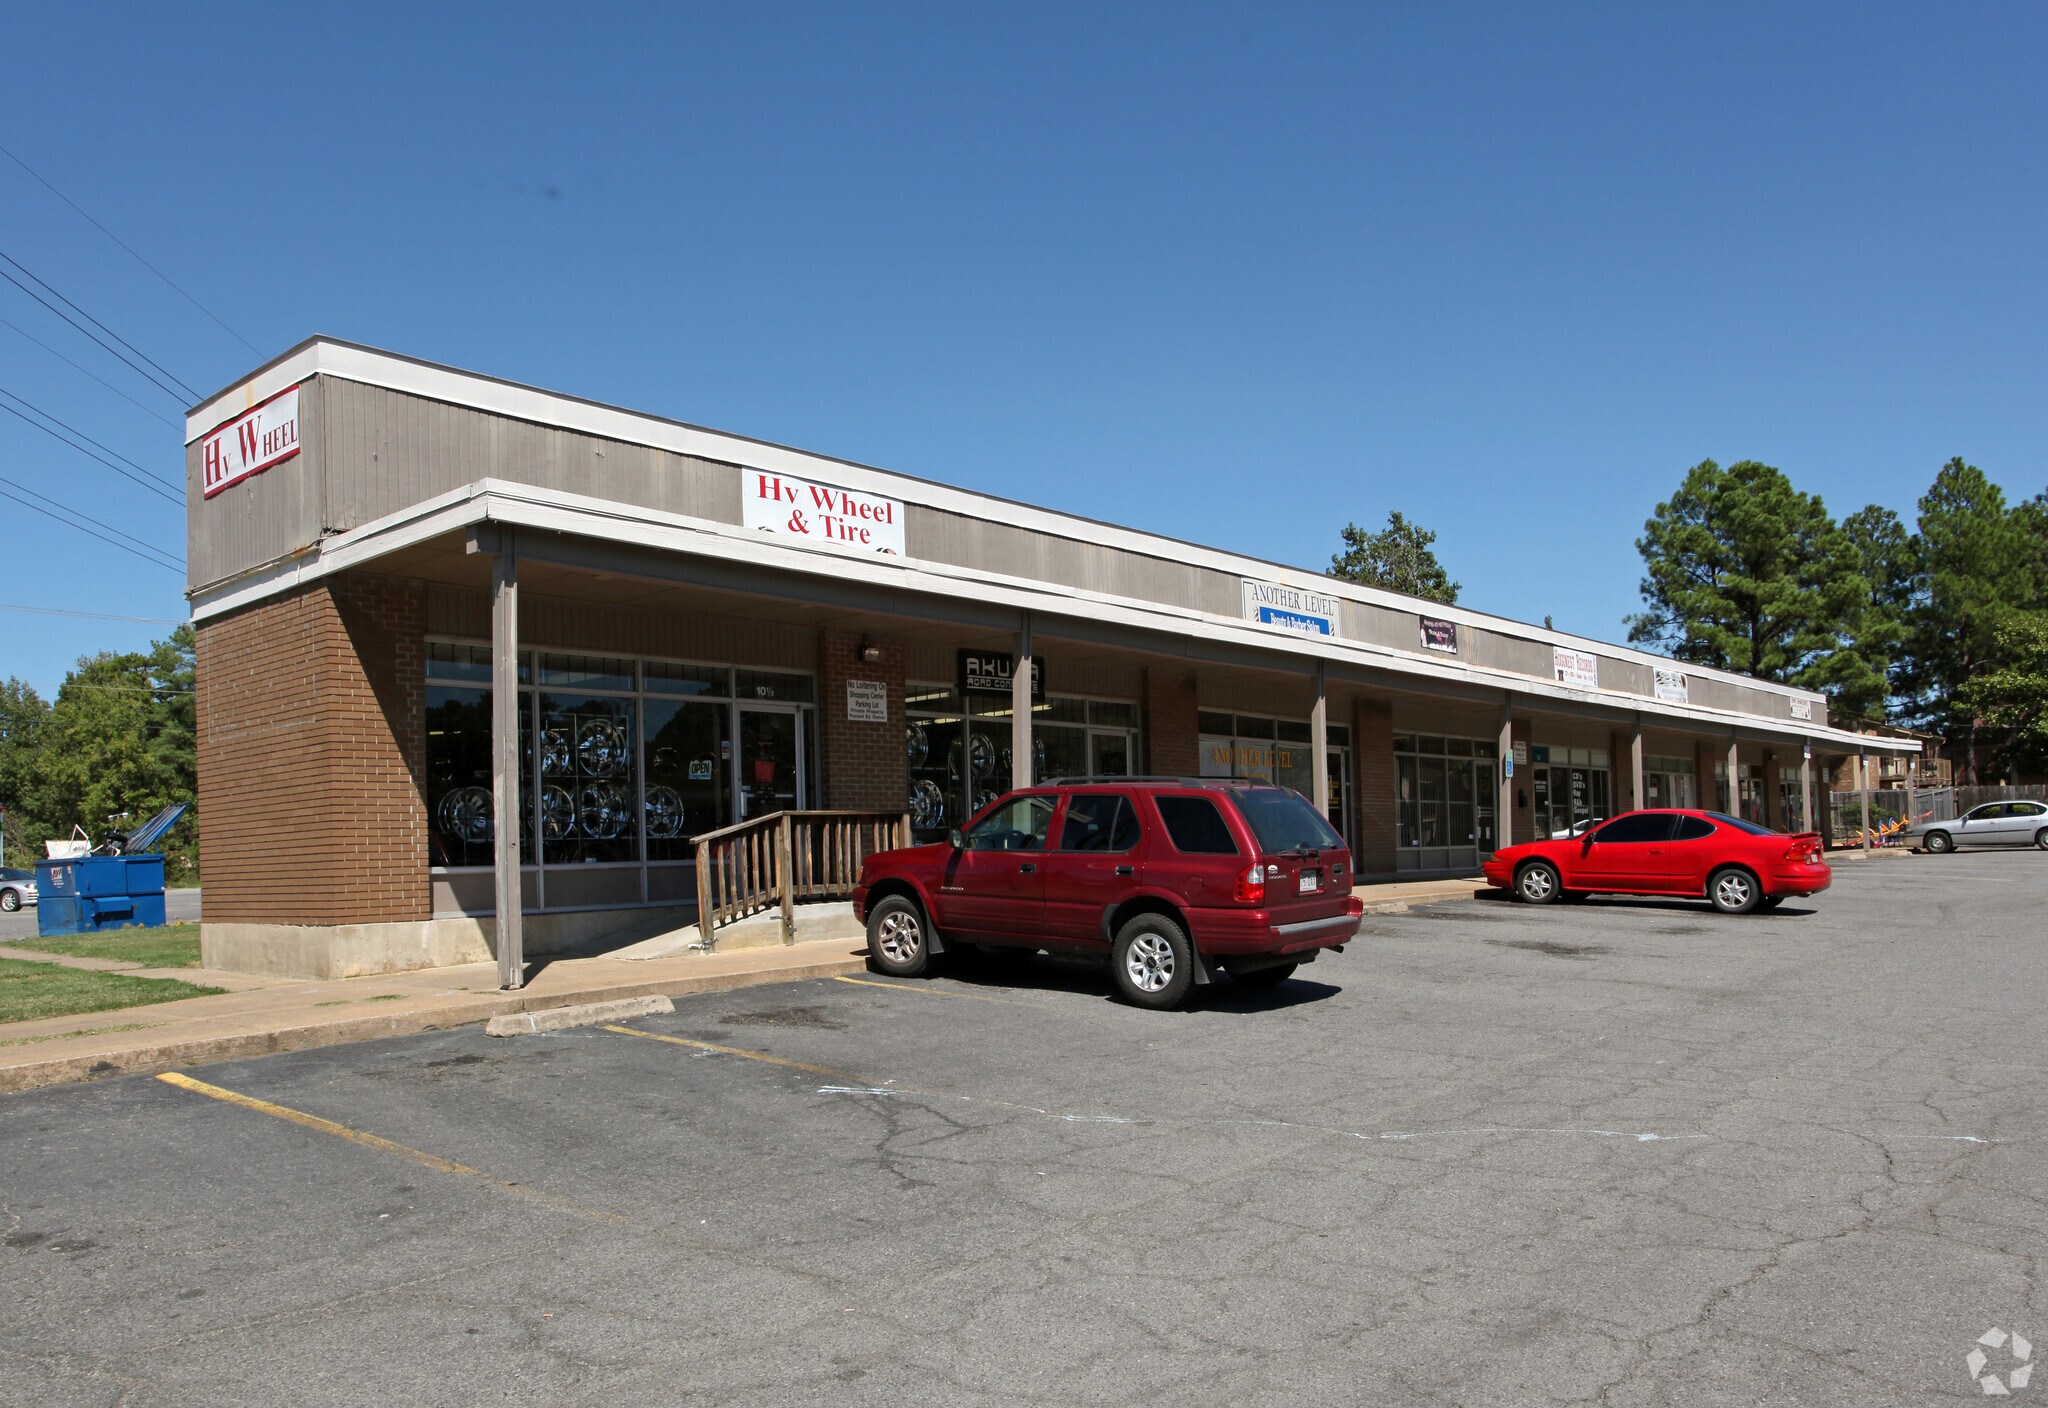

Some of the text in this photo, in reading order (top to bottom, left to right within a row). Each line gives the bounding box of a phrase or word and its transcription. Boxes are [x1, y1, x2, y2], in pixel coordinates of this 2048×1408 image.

[757, 475, 892, 524] Hv Wheel
[788, 509, 871, 544] & Tire
[1252, 582, 1334, 616] ANOTHER LEVEL
[966, 657, 1039, 681] AKUA
[848, 680, 855, 688] No
[856, 681, 878, 691] Loitering
[994, 680, 1039, 691] CONS
[850, 691, 869, 700] Shopping
[855, 700, 871, 709] Parking
[691, 763, 710, 774] OPEN
[1574, 806, 1589, 815] Gospel
